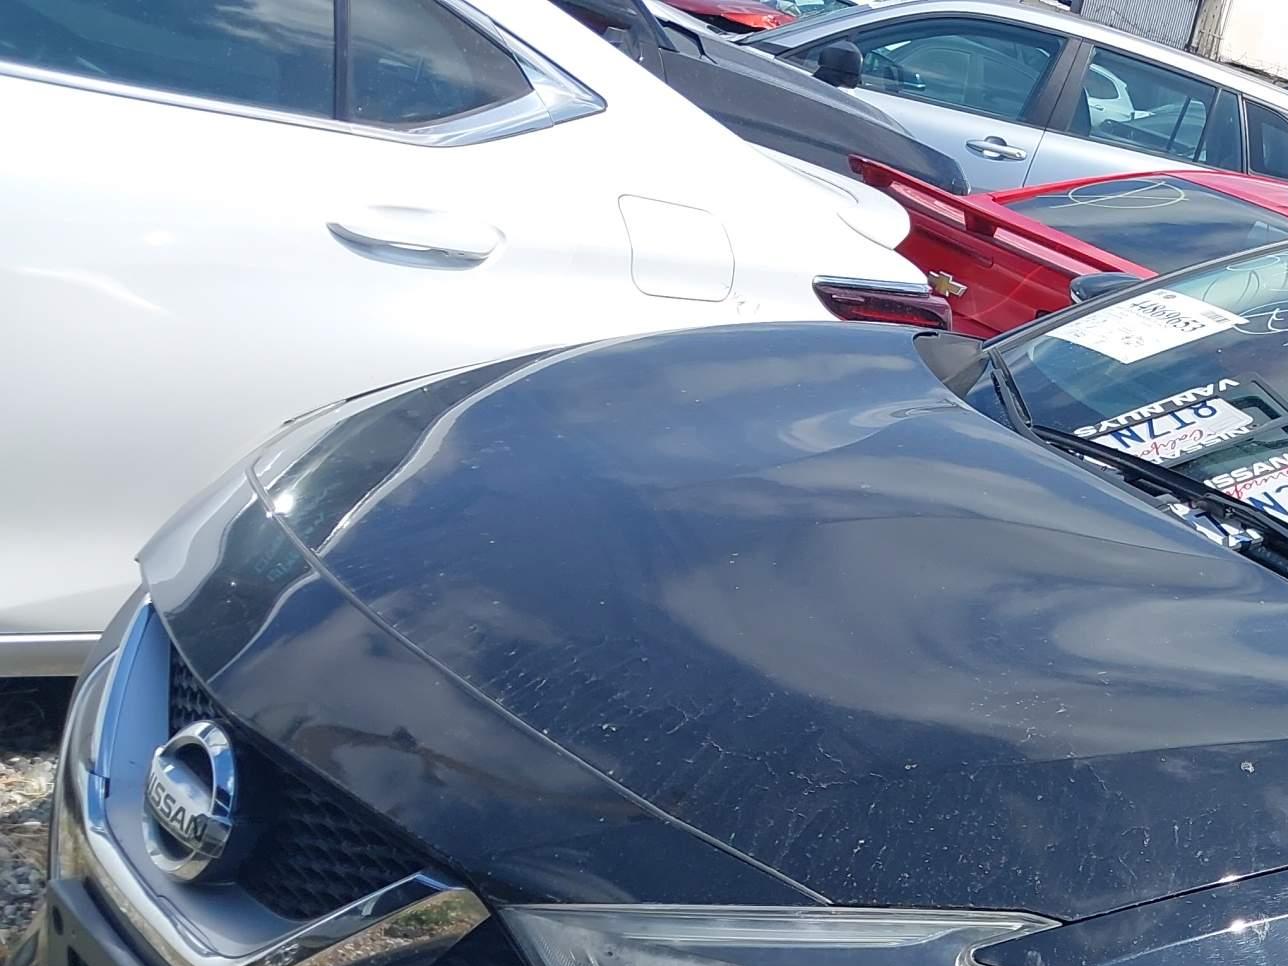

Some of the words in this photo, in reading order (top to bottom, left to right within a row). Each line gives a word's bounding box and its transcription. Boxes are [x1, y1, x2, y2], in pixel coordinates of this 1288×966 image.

[1174, 378, 1241, 404] VAN
[1074, 400, 1173, 438] NUYS
[1136, 429, 1204, 457] Califo
